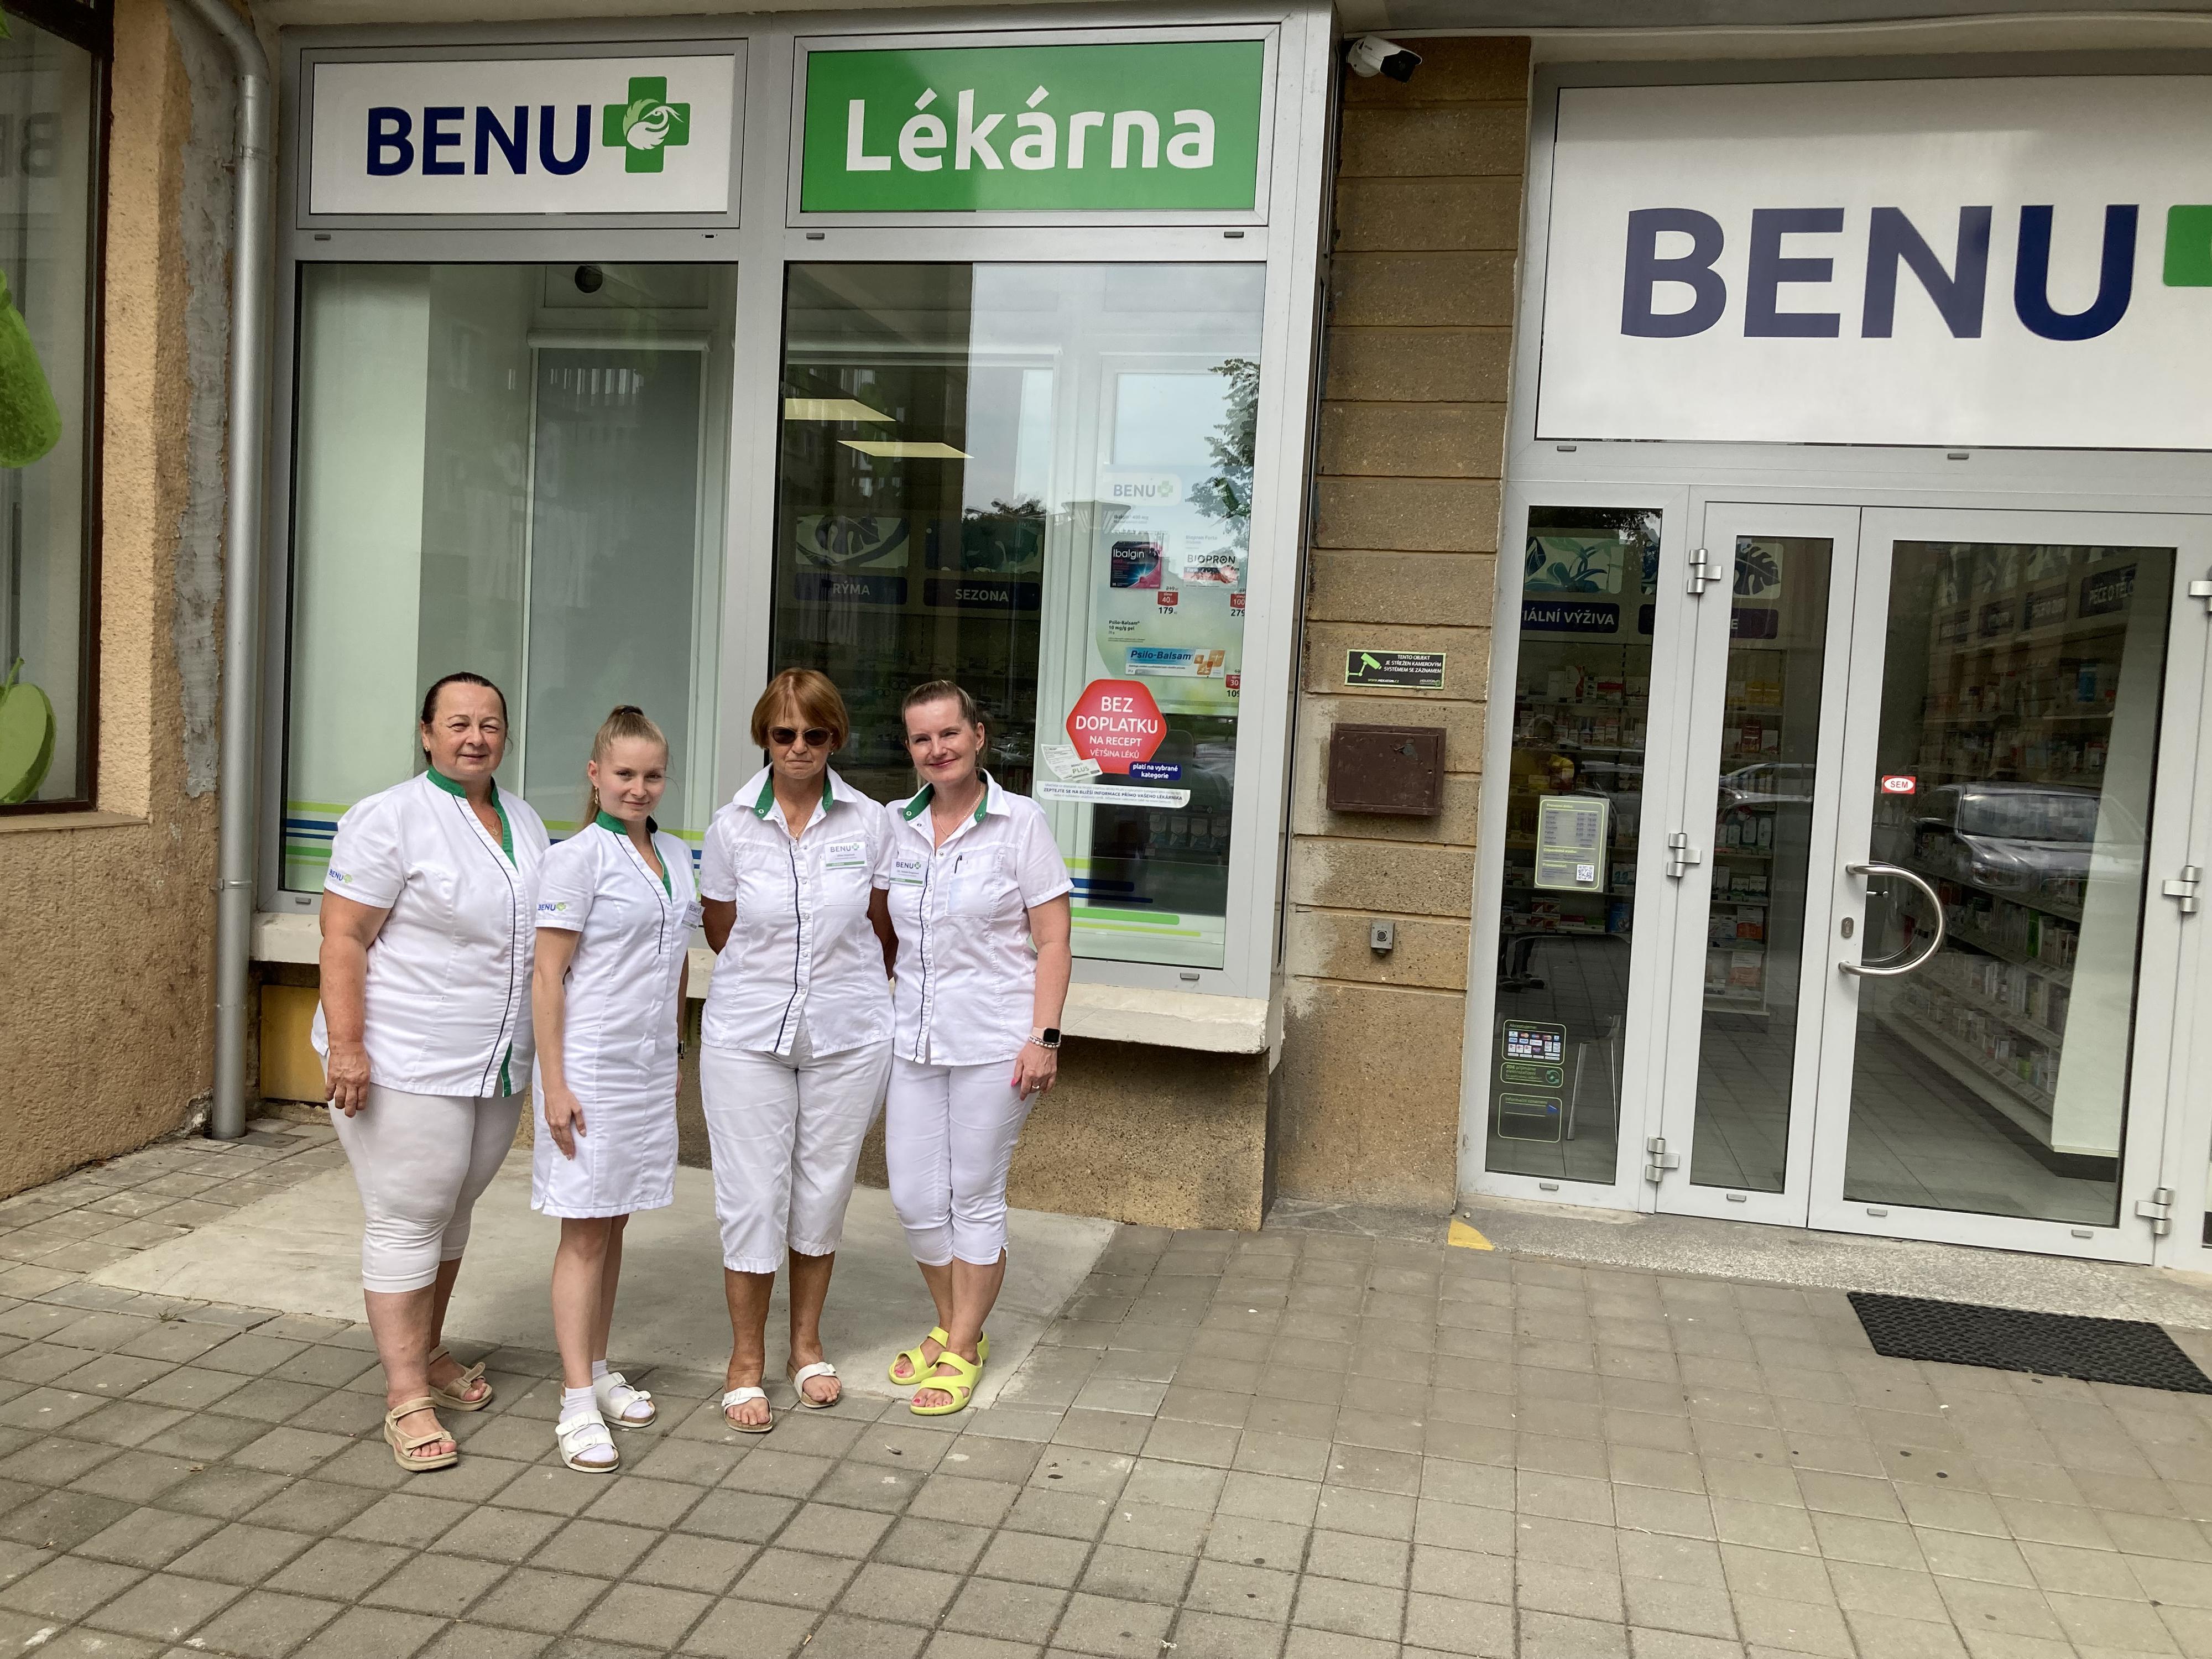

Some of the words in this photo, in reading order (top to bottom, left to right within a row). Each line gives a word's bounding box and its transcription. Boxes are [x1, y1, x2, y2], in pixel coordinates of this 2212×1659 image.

[846, 85, 1216, 171] Lékárna
[367, 105, 592, 176] BENU
[1620, 204, 2139, 341] BENU
[1113, 484, 1156, 497] BENU
[1113, 549, 1144, 560] Ibalgin
[1187, 554, 1235, 564] BIOPRON
[833, 581, 870, 595] RÝMA
[955, 589, 1009, 602] SEZONA
[1522, 607, 1561, 623] IÁLNÍ
[1564, 609, 1615, 625] VÝŽIVA
[1130, 650, 1191, 660] Psilo-Balsam
[1100, 696, 1133, 713] BEZ
[1076, 715, 1158, 734] DOPLATKU
[1089, 735, 1104, 744] NA
[1105, 736, 1142, 747] RECEPT
[1090, 748, 1120, 758] VĚTŠINA
[1121, 749, 1139, 759] LÉKŮ
[1072, 766, 1089, 774] PLUS
[328, 869, 344, 881] BENU
